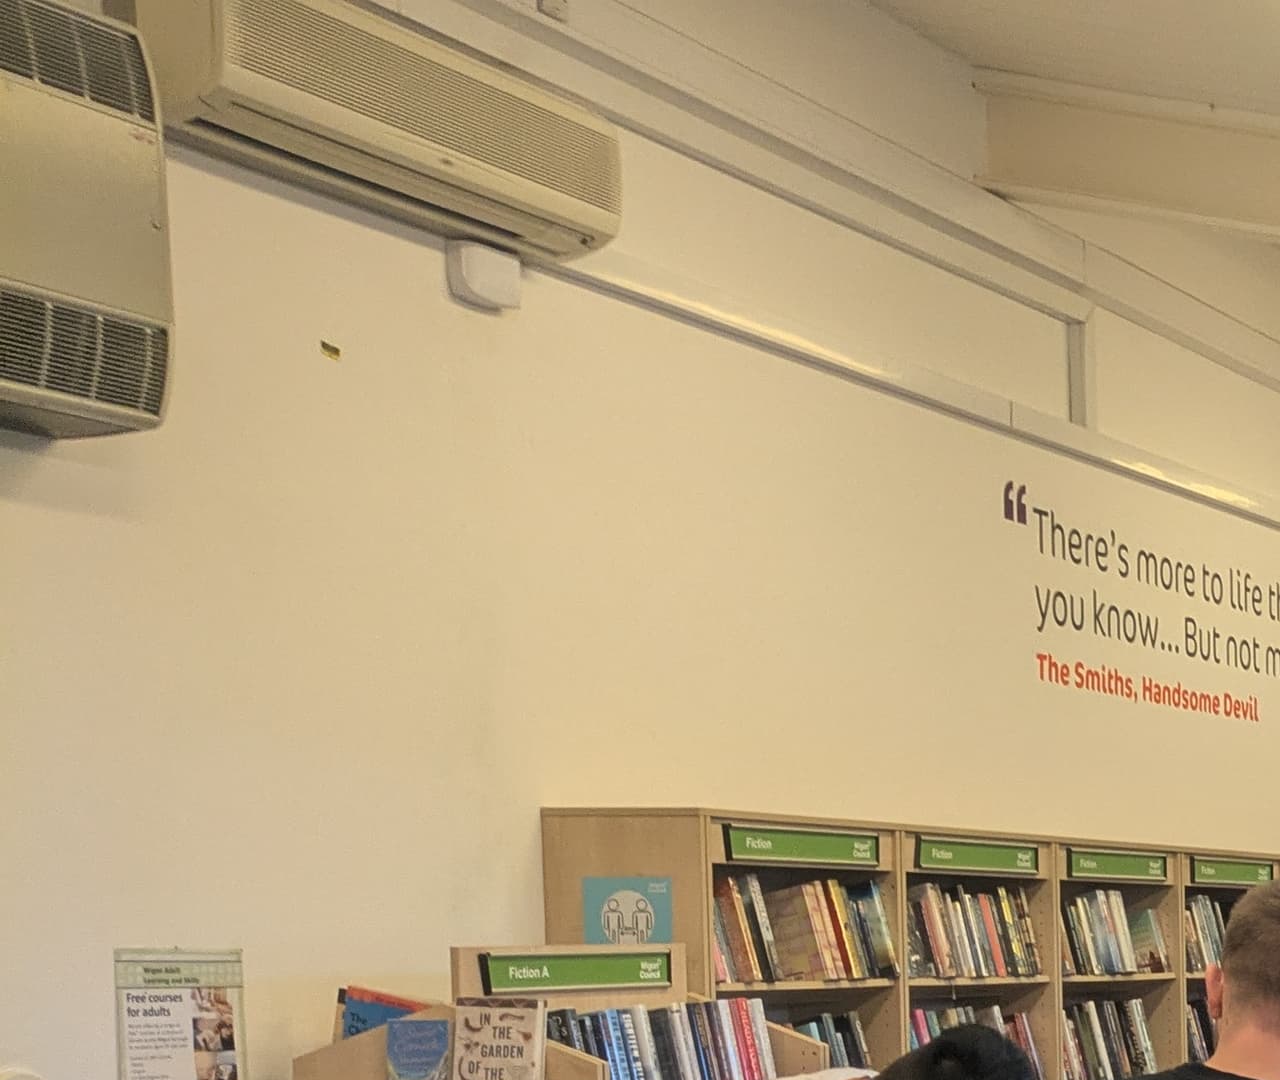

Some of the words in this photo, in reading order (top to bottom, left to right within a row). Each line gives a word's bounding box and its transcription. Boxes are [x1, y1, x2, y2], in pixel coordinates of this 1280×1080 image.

[1137, 550, 1195, 597] more
[1202, 563, 1223, 605] to
[1229, 568, 1262, 616] life
[1035, 585, 1085, 632] you
[1185, 617, 1220, 664] But
[1226, 636, 1260, 673] not
[1036, 653, 1070, 686] The
[1074, 662, 1138, 703] Smiths,
[1142, 675, 1220, 715] Handsome
[1223, 693, 1259, 722] Devil
[745, 837, 773, 850] Fiction
[931, 848, 953, 860] Fiction
[509, 966, 540, 979] Fiction
[541, 966, 550, 978] A
[126, 993, 147, 1003] Free
[148, 994, 183, 1003] courses
[127, 1007, 141, 1017] for
[142, 1006, 171, 1017] adults
[479, 1013, 491, 1026] IN
[492, 1026, 512, 1040] THE
[480, 1045, 524, 1058] GARDEN
[468, 1060, 481, 1074] OF
[484, 1067, 504, 1080] THE
